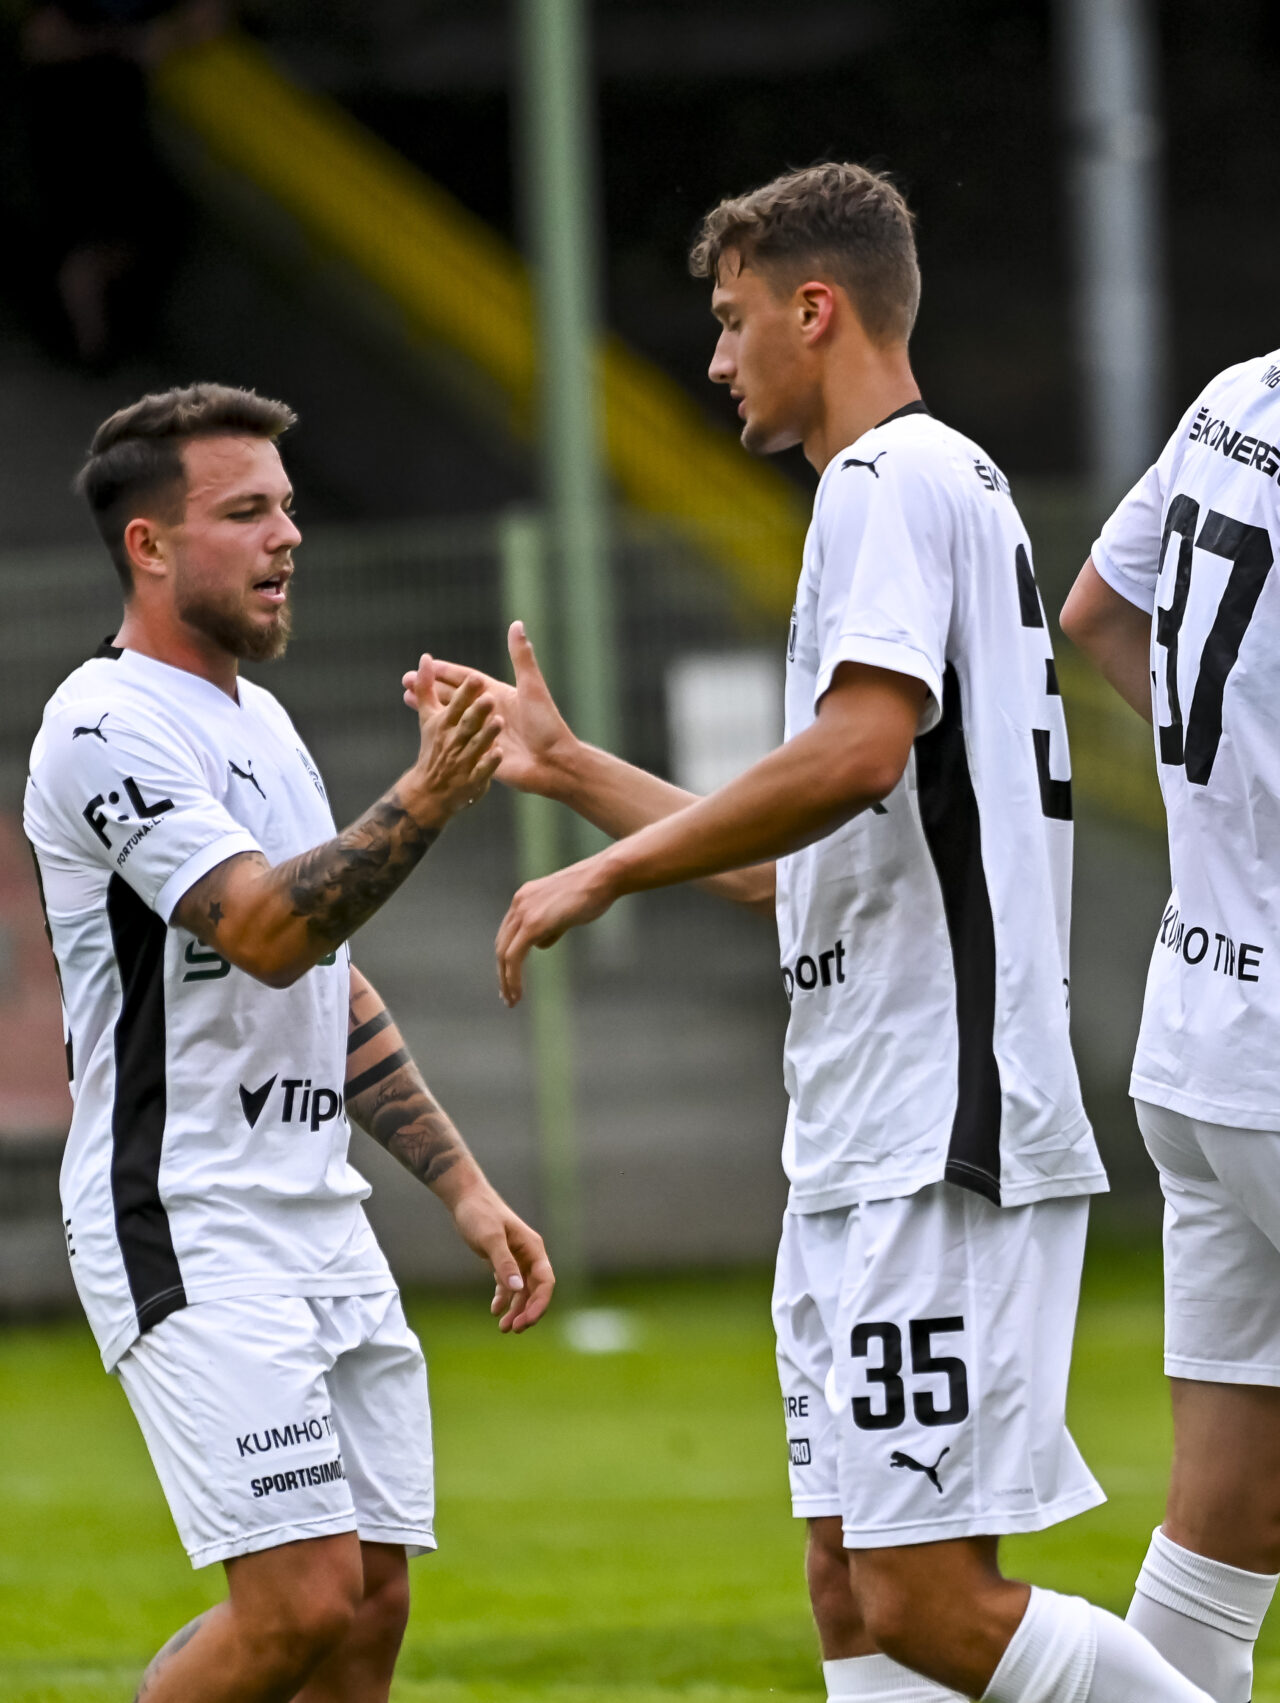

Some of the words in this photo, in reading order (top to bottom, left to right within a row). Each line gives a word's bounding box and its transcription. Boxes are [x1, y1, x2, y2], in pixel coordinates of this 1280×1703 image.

[281, 1079, 342, 1132] Tip
[850, 1316, 969, 1431] 35
[236, 1419, 323, 1457] KUMHO
